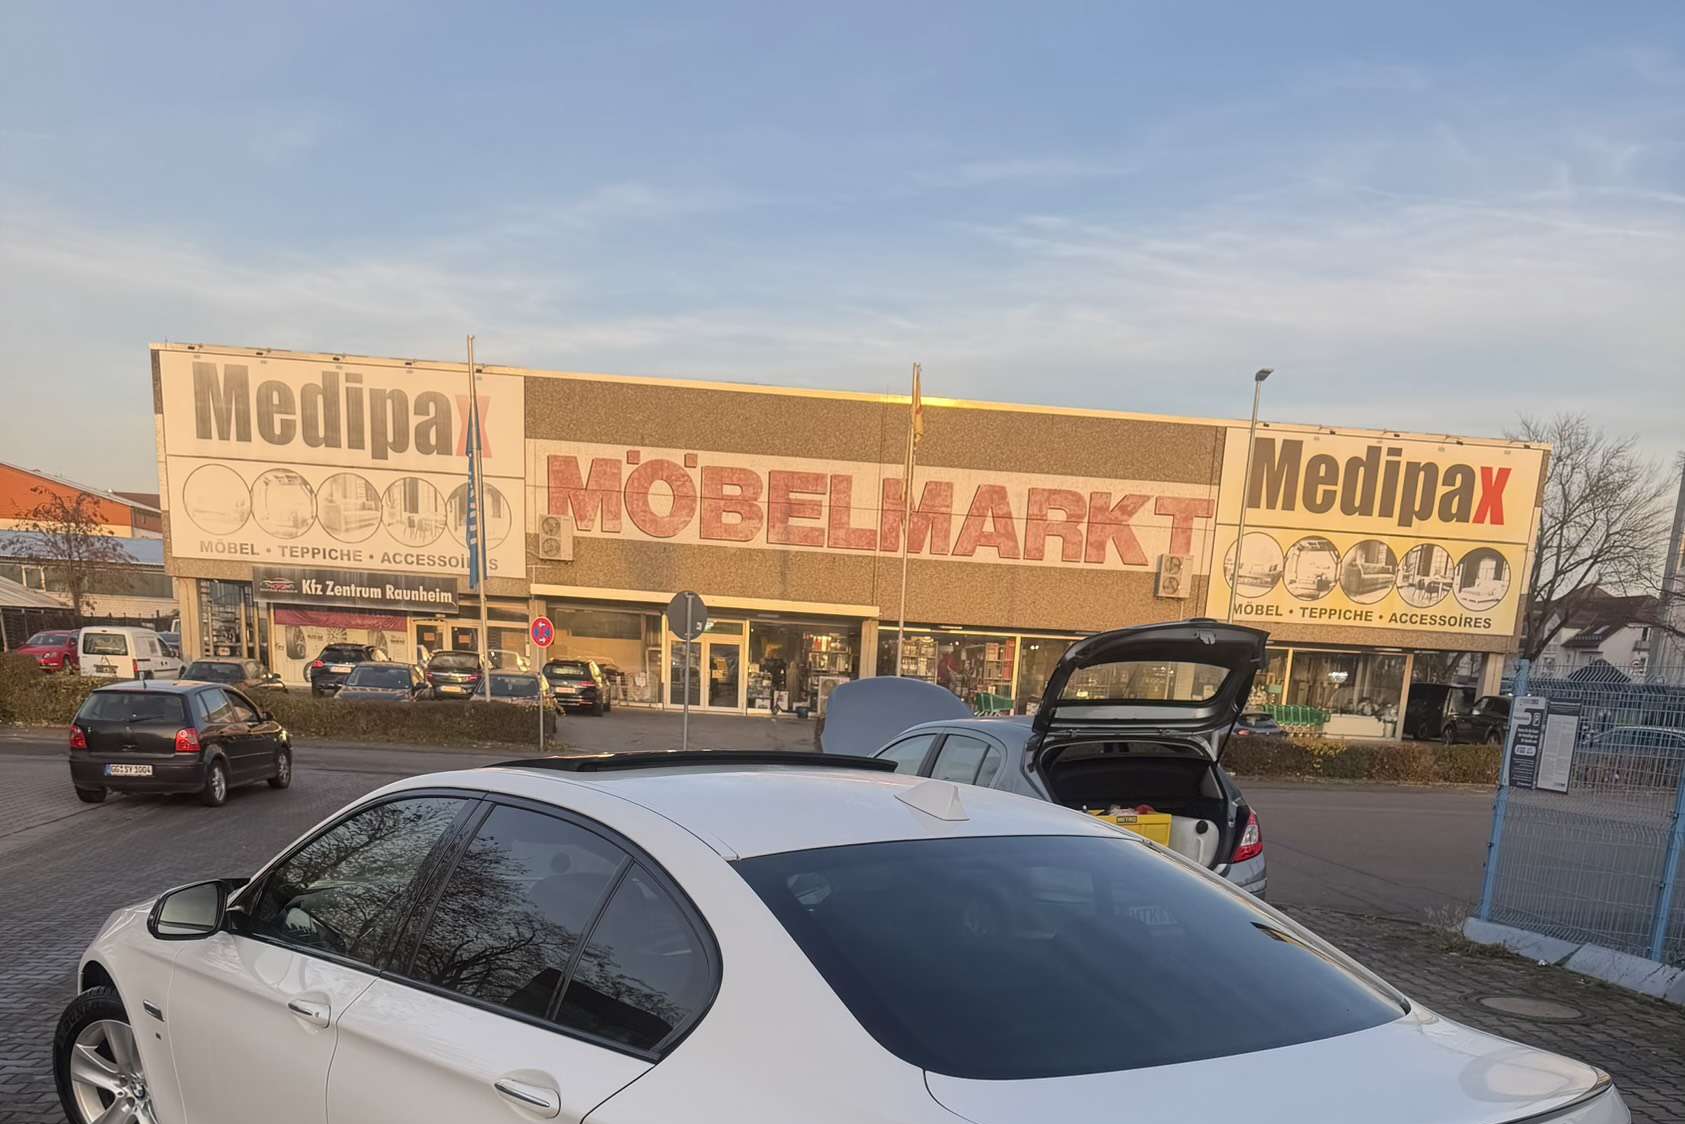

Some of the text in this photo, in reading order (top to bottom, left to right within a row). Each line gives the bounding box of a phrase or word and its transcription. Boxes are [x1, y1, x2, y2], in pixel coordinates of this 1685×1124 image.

[192, 362, 492, 460] Medipax
[1246, 437, 1512, 528] Medipax
[200, 541, 498, 570] MÖBEL TEPPICHE ACCESSOİS
[302, 579, 452, 603] Kfz Zentrum Raunheim
[1233, 601, 1283, 617] MÖBEL
[1300, 607, 1373, 622] TEPPICHE
